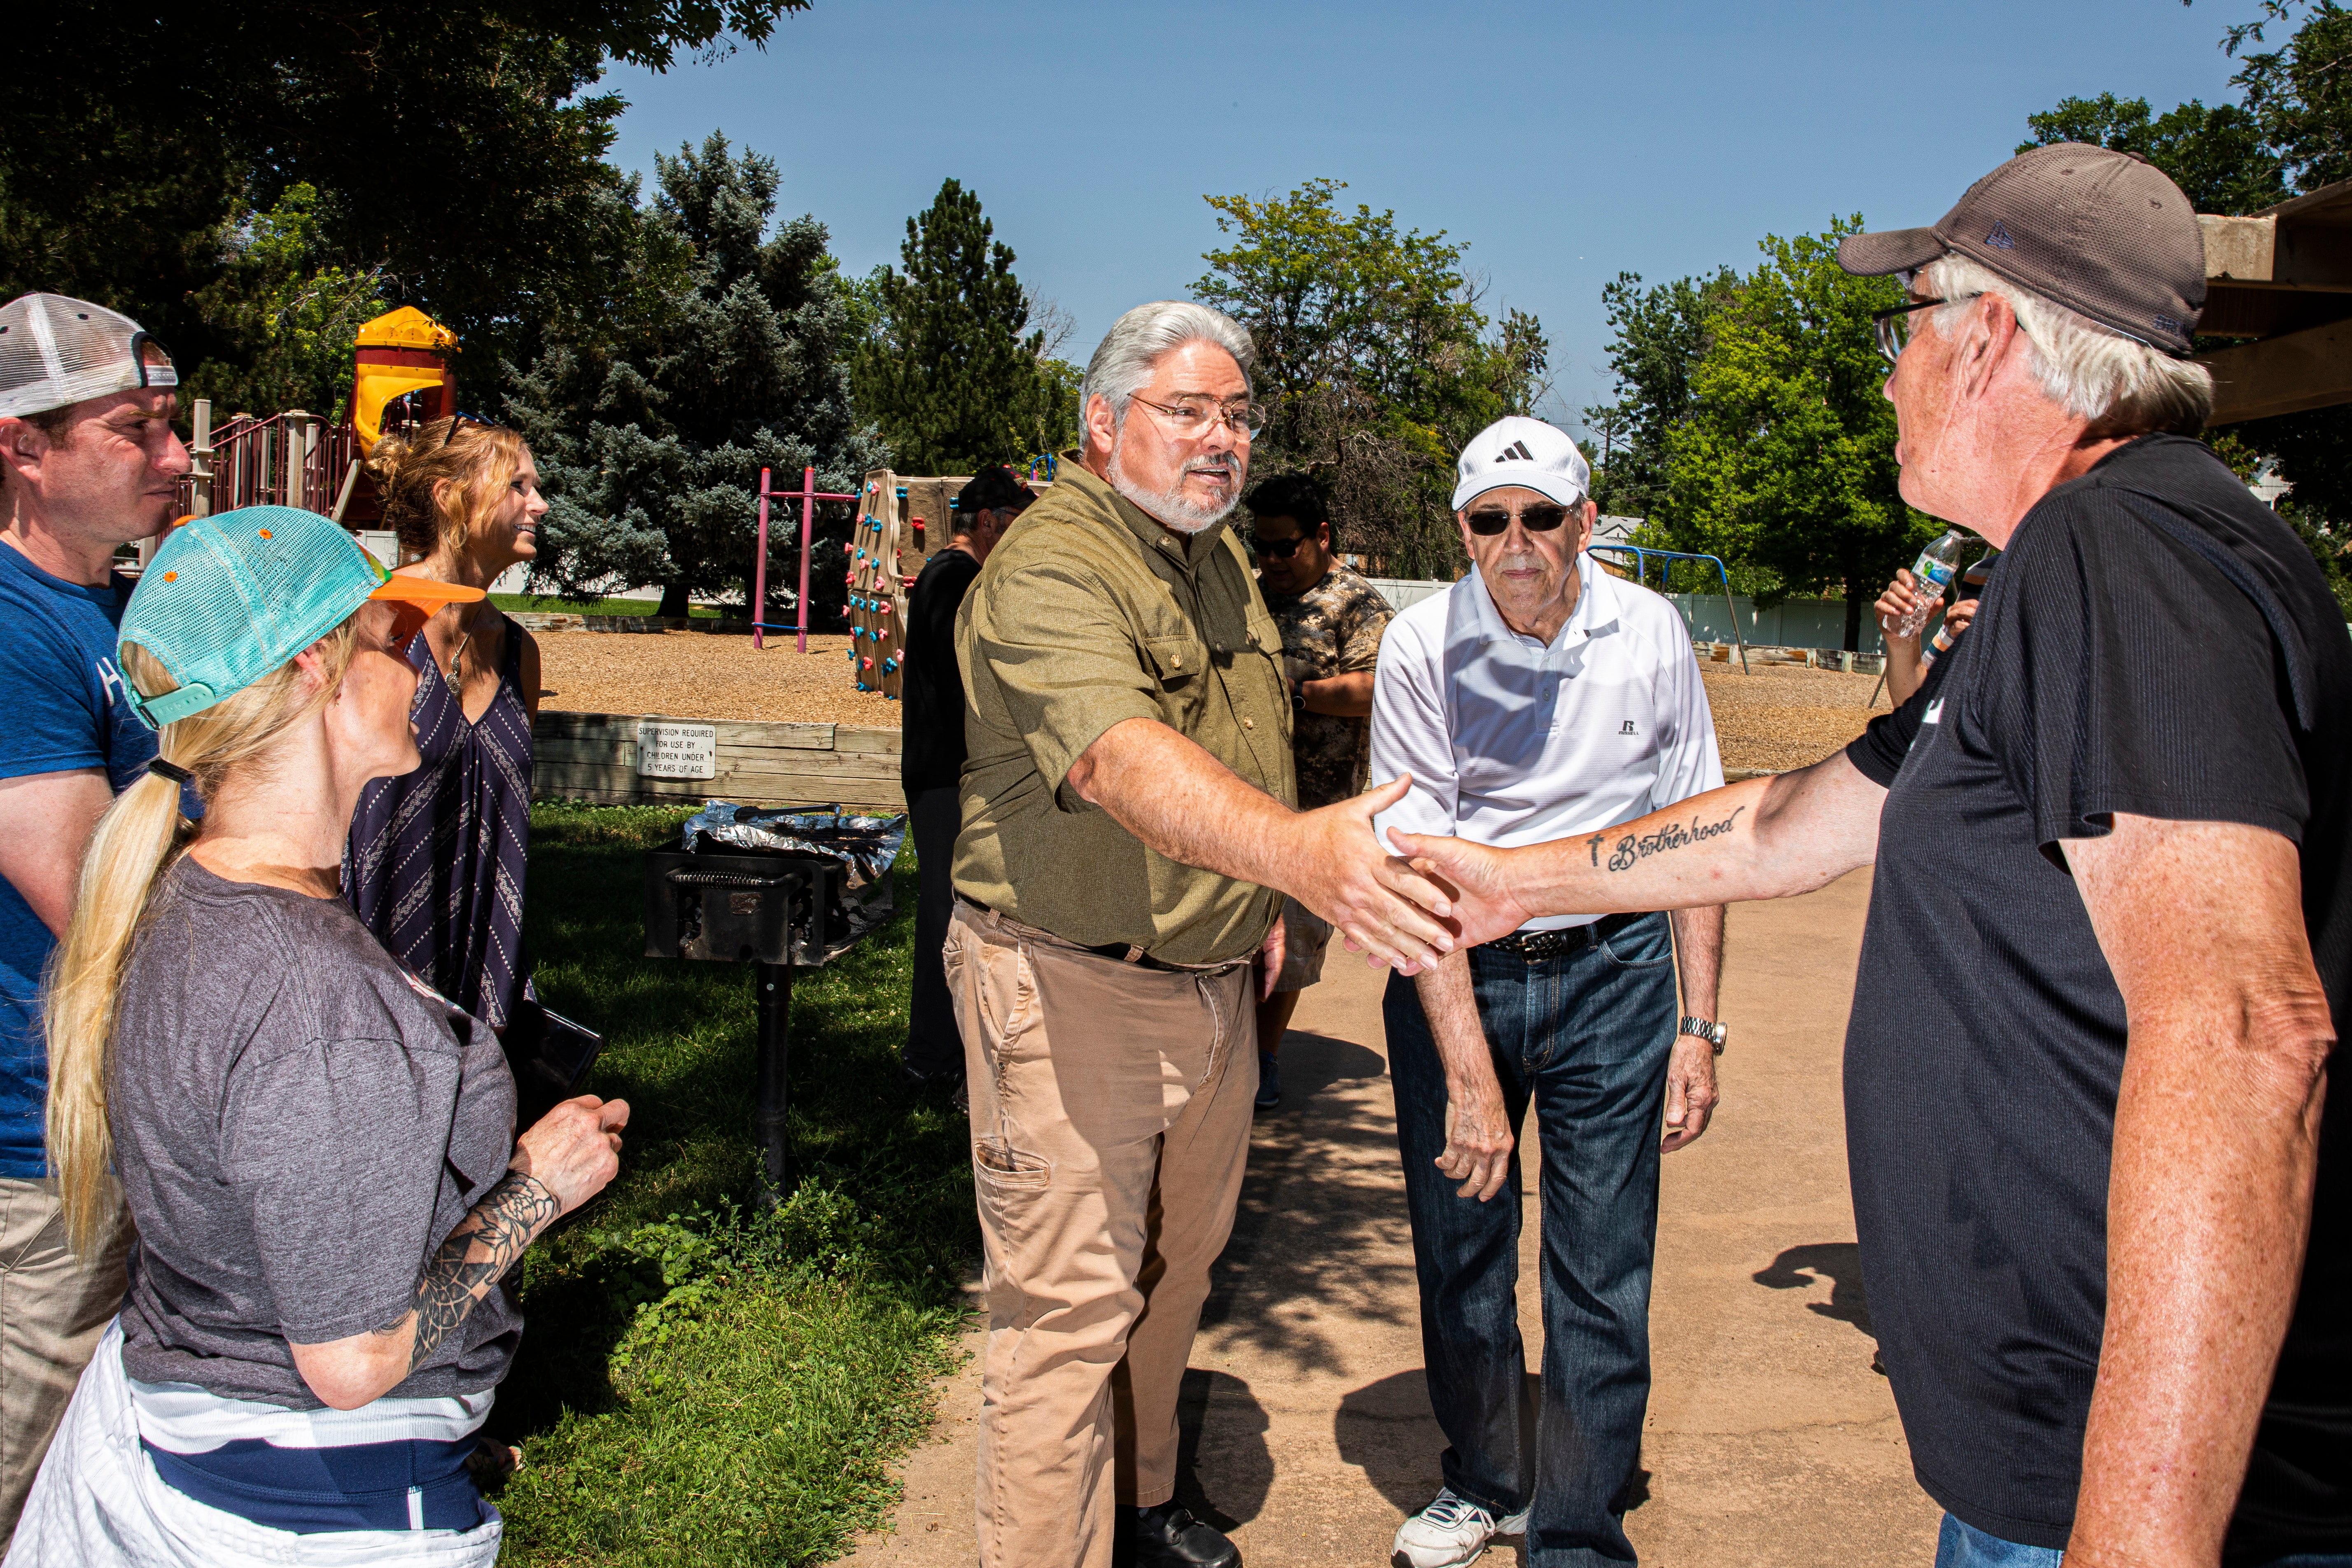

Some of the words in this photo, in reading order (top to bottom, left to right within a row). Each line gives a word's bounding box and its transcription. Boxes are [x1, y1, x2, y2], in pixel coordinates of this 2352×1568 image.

[639, 728, 679, 736] SUPERVISION
[682, 729, 714, 737] REQUIRED
[647, 751, 679, 760] CHILDREN
[682, 753, 704, 761] UNDER
[654, 764, 675, 772] YEARS
[679, 765, 688, 773] OF
[1608, 805, 1745, 872] Brotherhood
